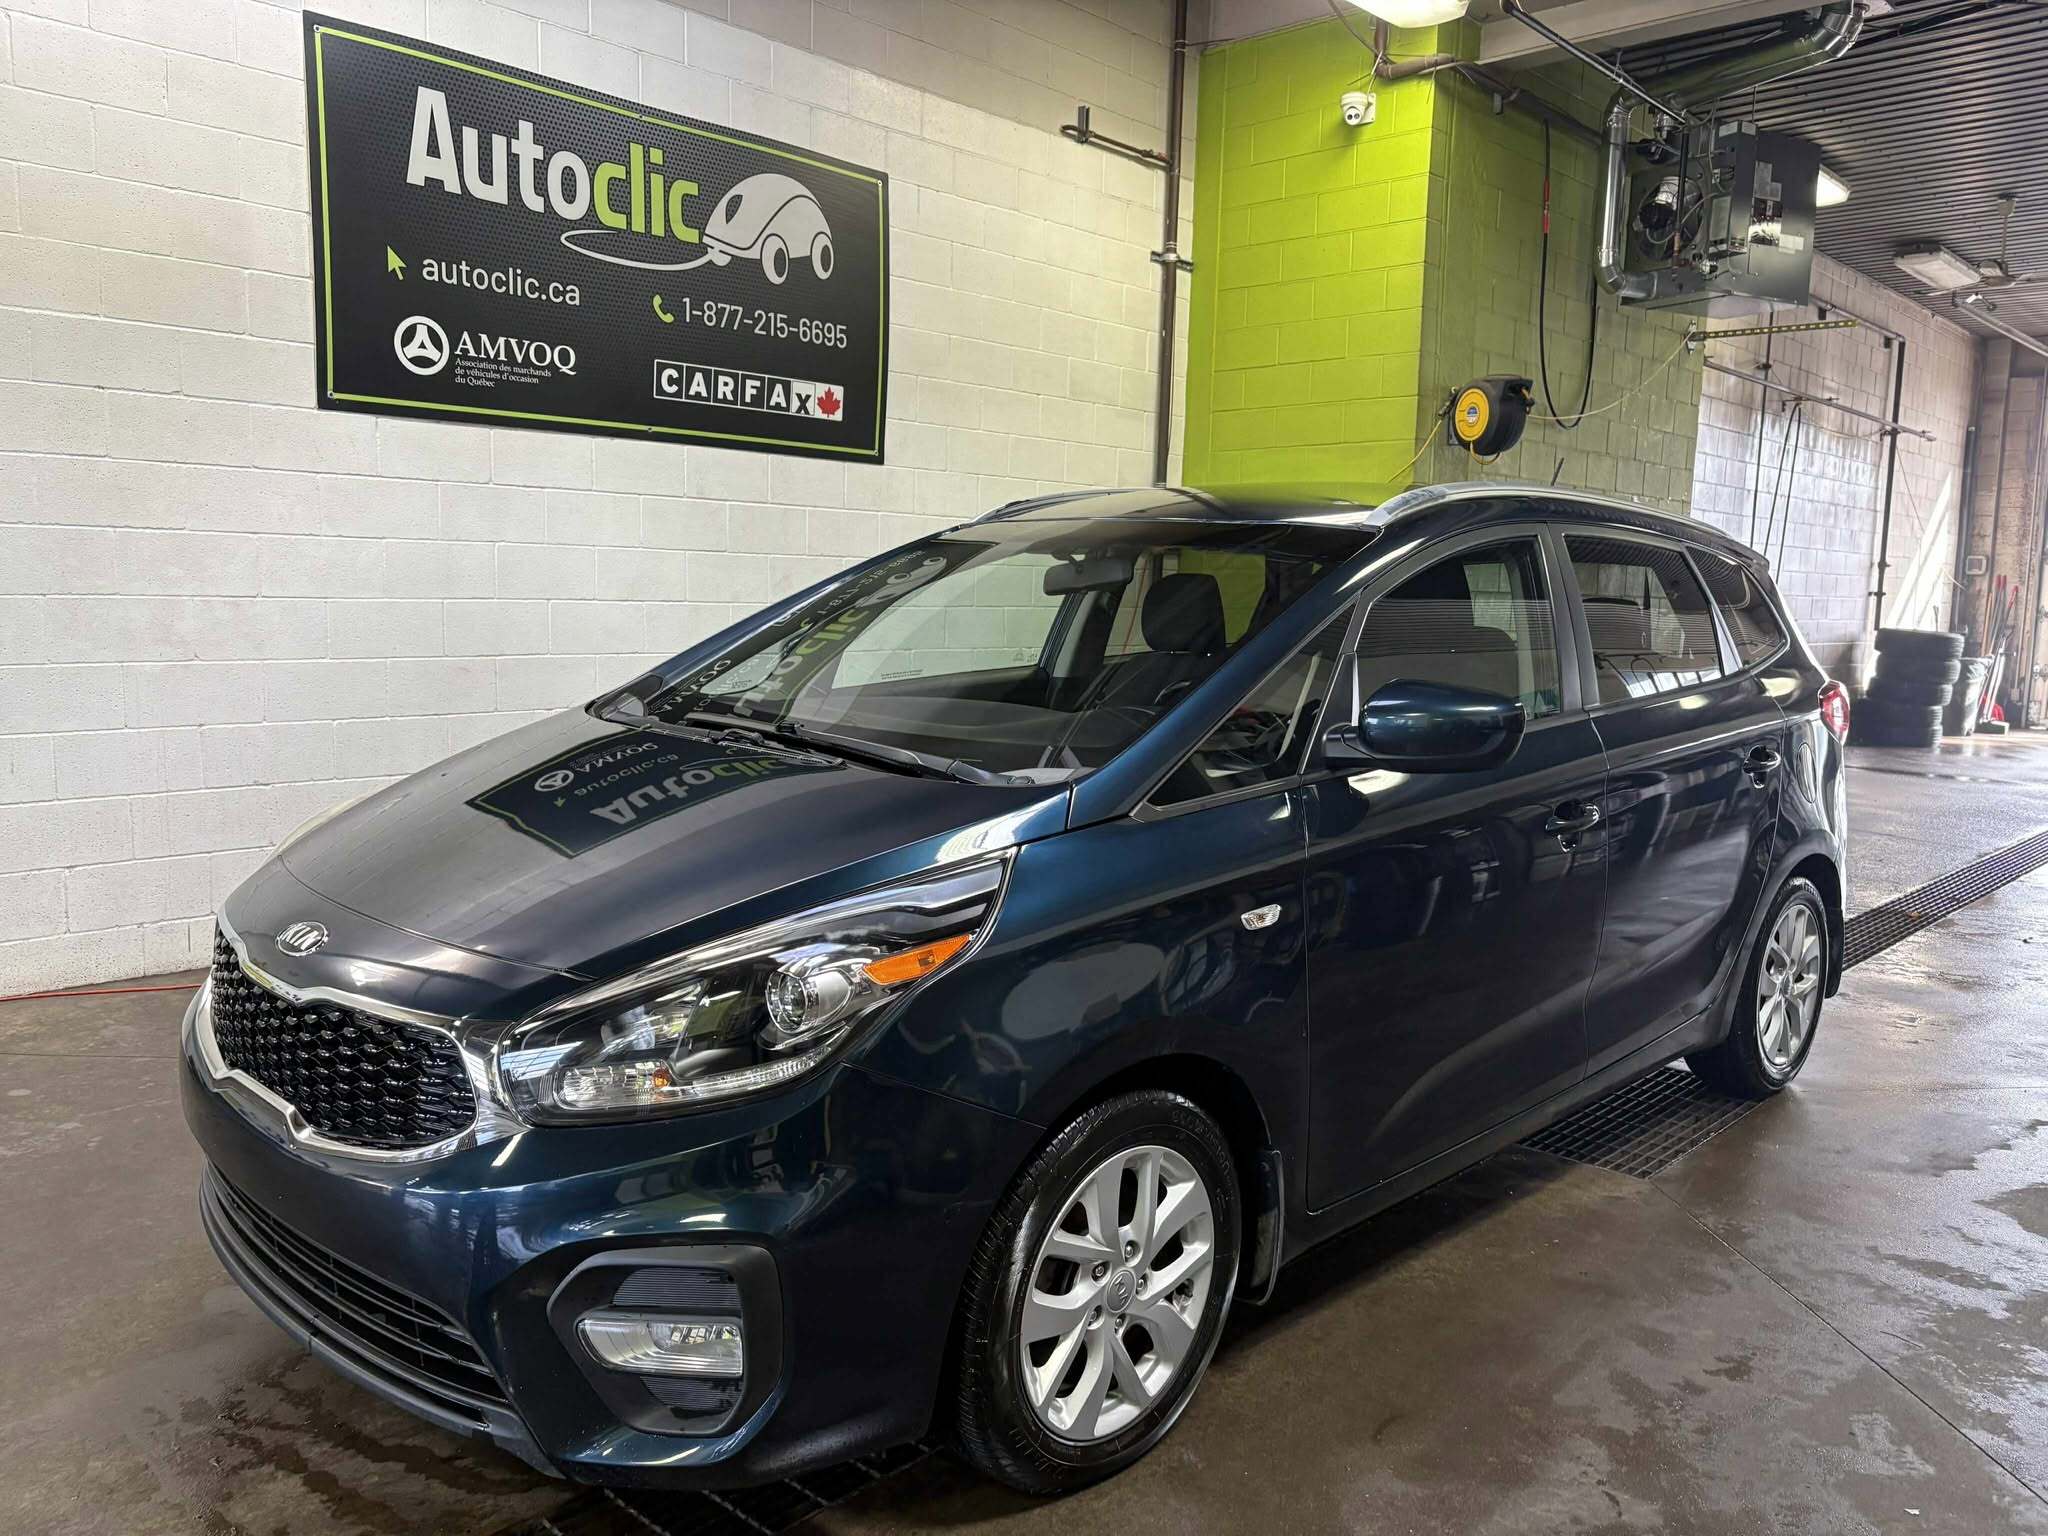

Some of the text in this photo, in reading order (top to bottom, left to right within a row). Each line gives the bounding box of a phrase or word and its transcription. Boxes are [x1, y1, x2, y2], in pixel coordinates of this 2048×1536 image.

[406, 85, 699, 244] Autoclic
[422, 258, 580, 306] autoclic.ca
[682, 297, 848, 349] 1-877-215-6695
[454, 330, 577, 375] AMVOQ
[455, 358, 552, 378] Association des marchands
[455, 366, 539, 385] de véhicules d'occasion
[455, 375, 496, 388] du Québec
[660, 367, 811, 416] CARFAX
